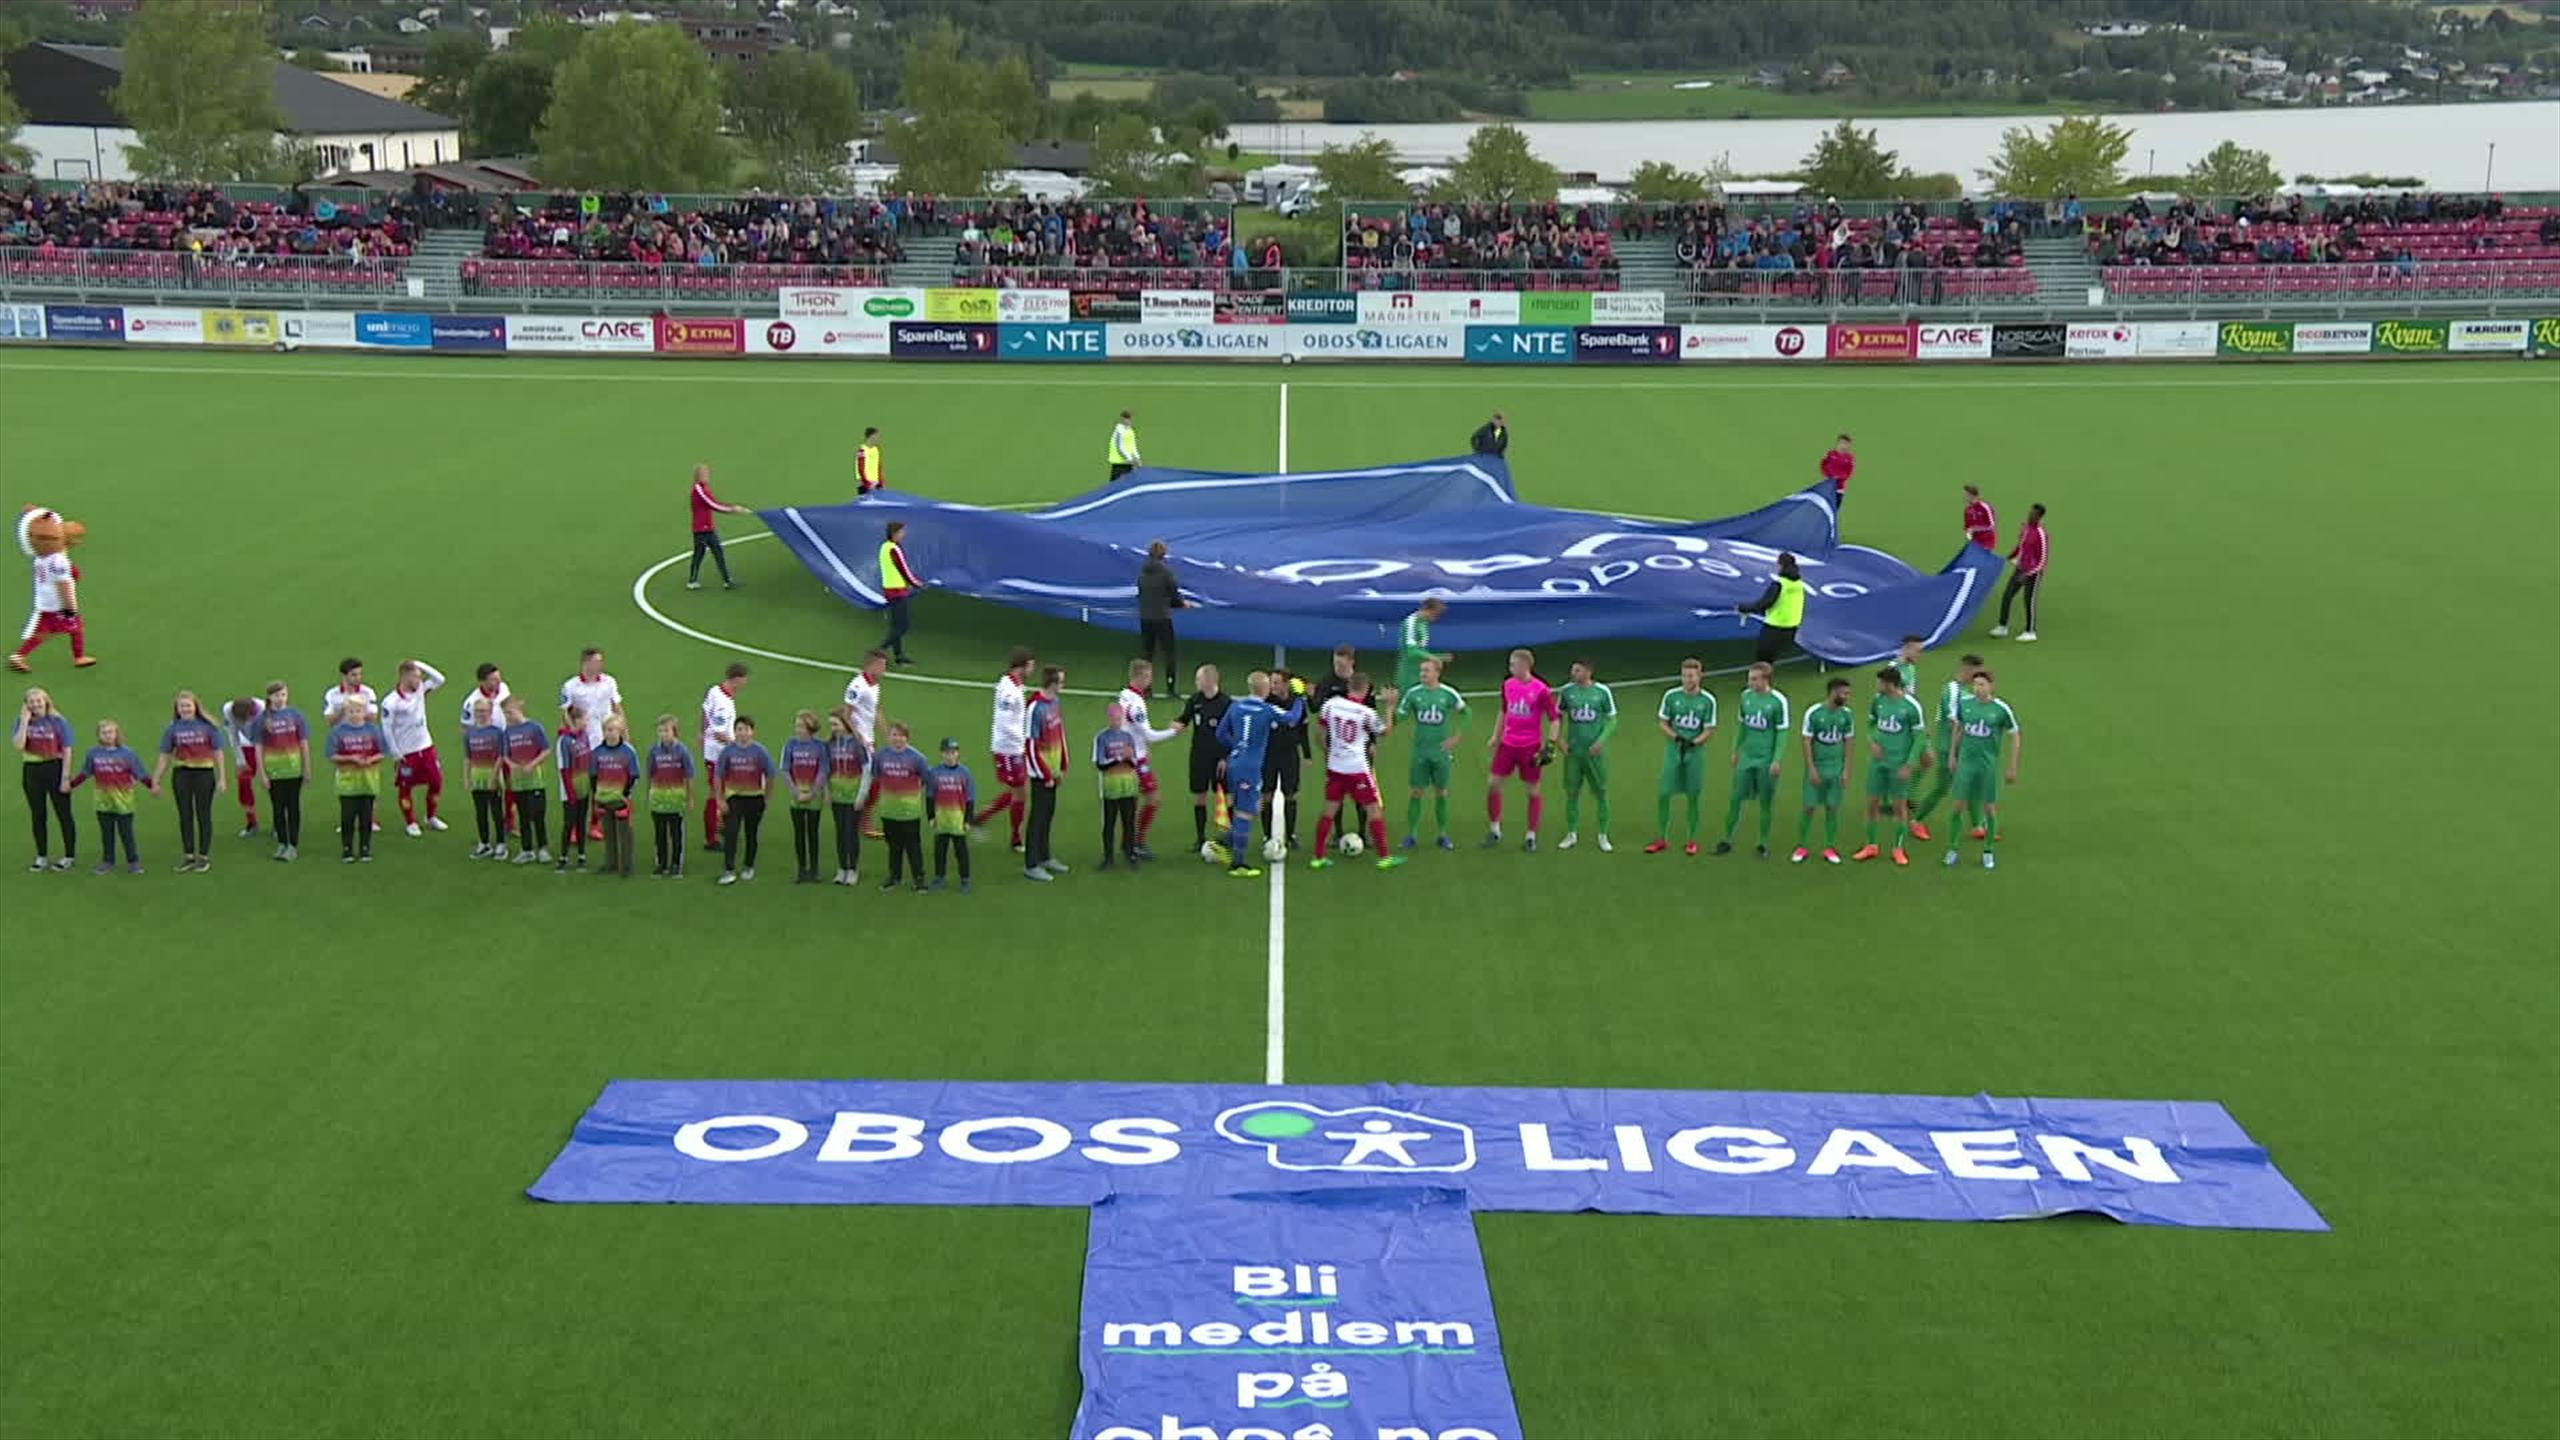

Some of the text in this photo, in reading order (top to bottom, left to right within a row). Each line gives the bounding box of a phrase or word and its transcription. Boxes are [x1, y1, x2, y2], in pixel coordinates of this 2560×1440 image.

[1288, 299, 1355, 312] KREDITOR
[581, 321, 645, 339] CARE
[691, 327, 733, 339] EXTRA
[770, 330, 792, 344] TB
[898, 329, 967, 343] SpareBank
[1919, 328, 1983, 344] CARE
[1996, 330, 2064, 344] NORSCAN
[2069, 329, 2109, 339] xerox
[2221, 323, 2290, 351] Kvam
[2376, 322, 2445, 350] Kvam
[1046, 330, 1099, 351] NTE
[1124, 333, 1269, 349] OBOS LIGAEN
[1303, 334, 1448, 349] OBOS LIGAEN
[1512, 332, 1567, 354] NTE
[1580, 332, 1649, 347] SpareBank
[1779, 333, 1801, 349] TB
[1864, 332, 1905, 345] EXTRA
[1242, 714, 1251, 742] 1
[1334, 716, 1359, 744] 10
[674, 1111, 2183, 1184] OBOS LIGAEN
[1233, 1264, 1338, 1297] Bli
[1103, 1311, 1475, 1347] medlem
[1236, 1362, 1350, 1409] på
